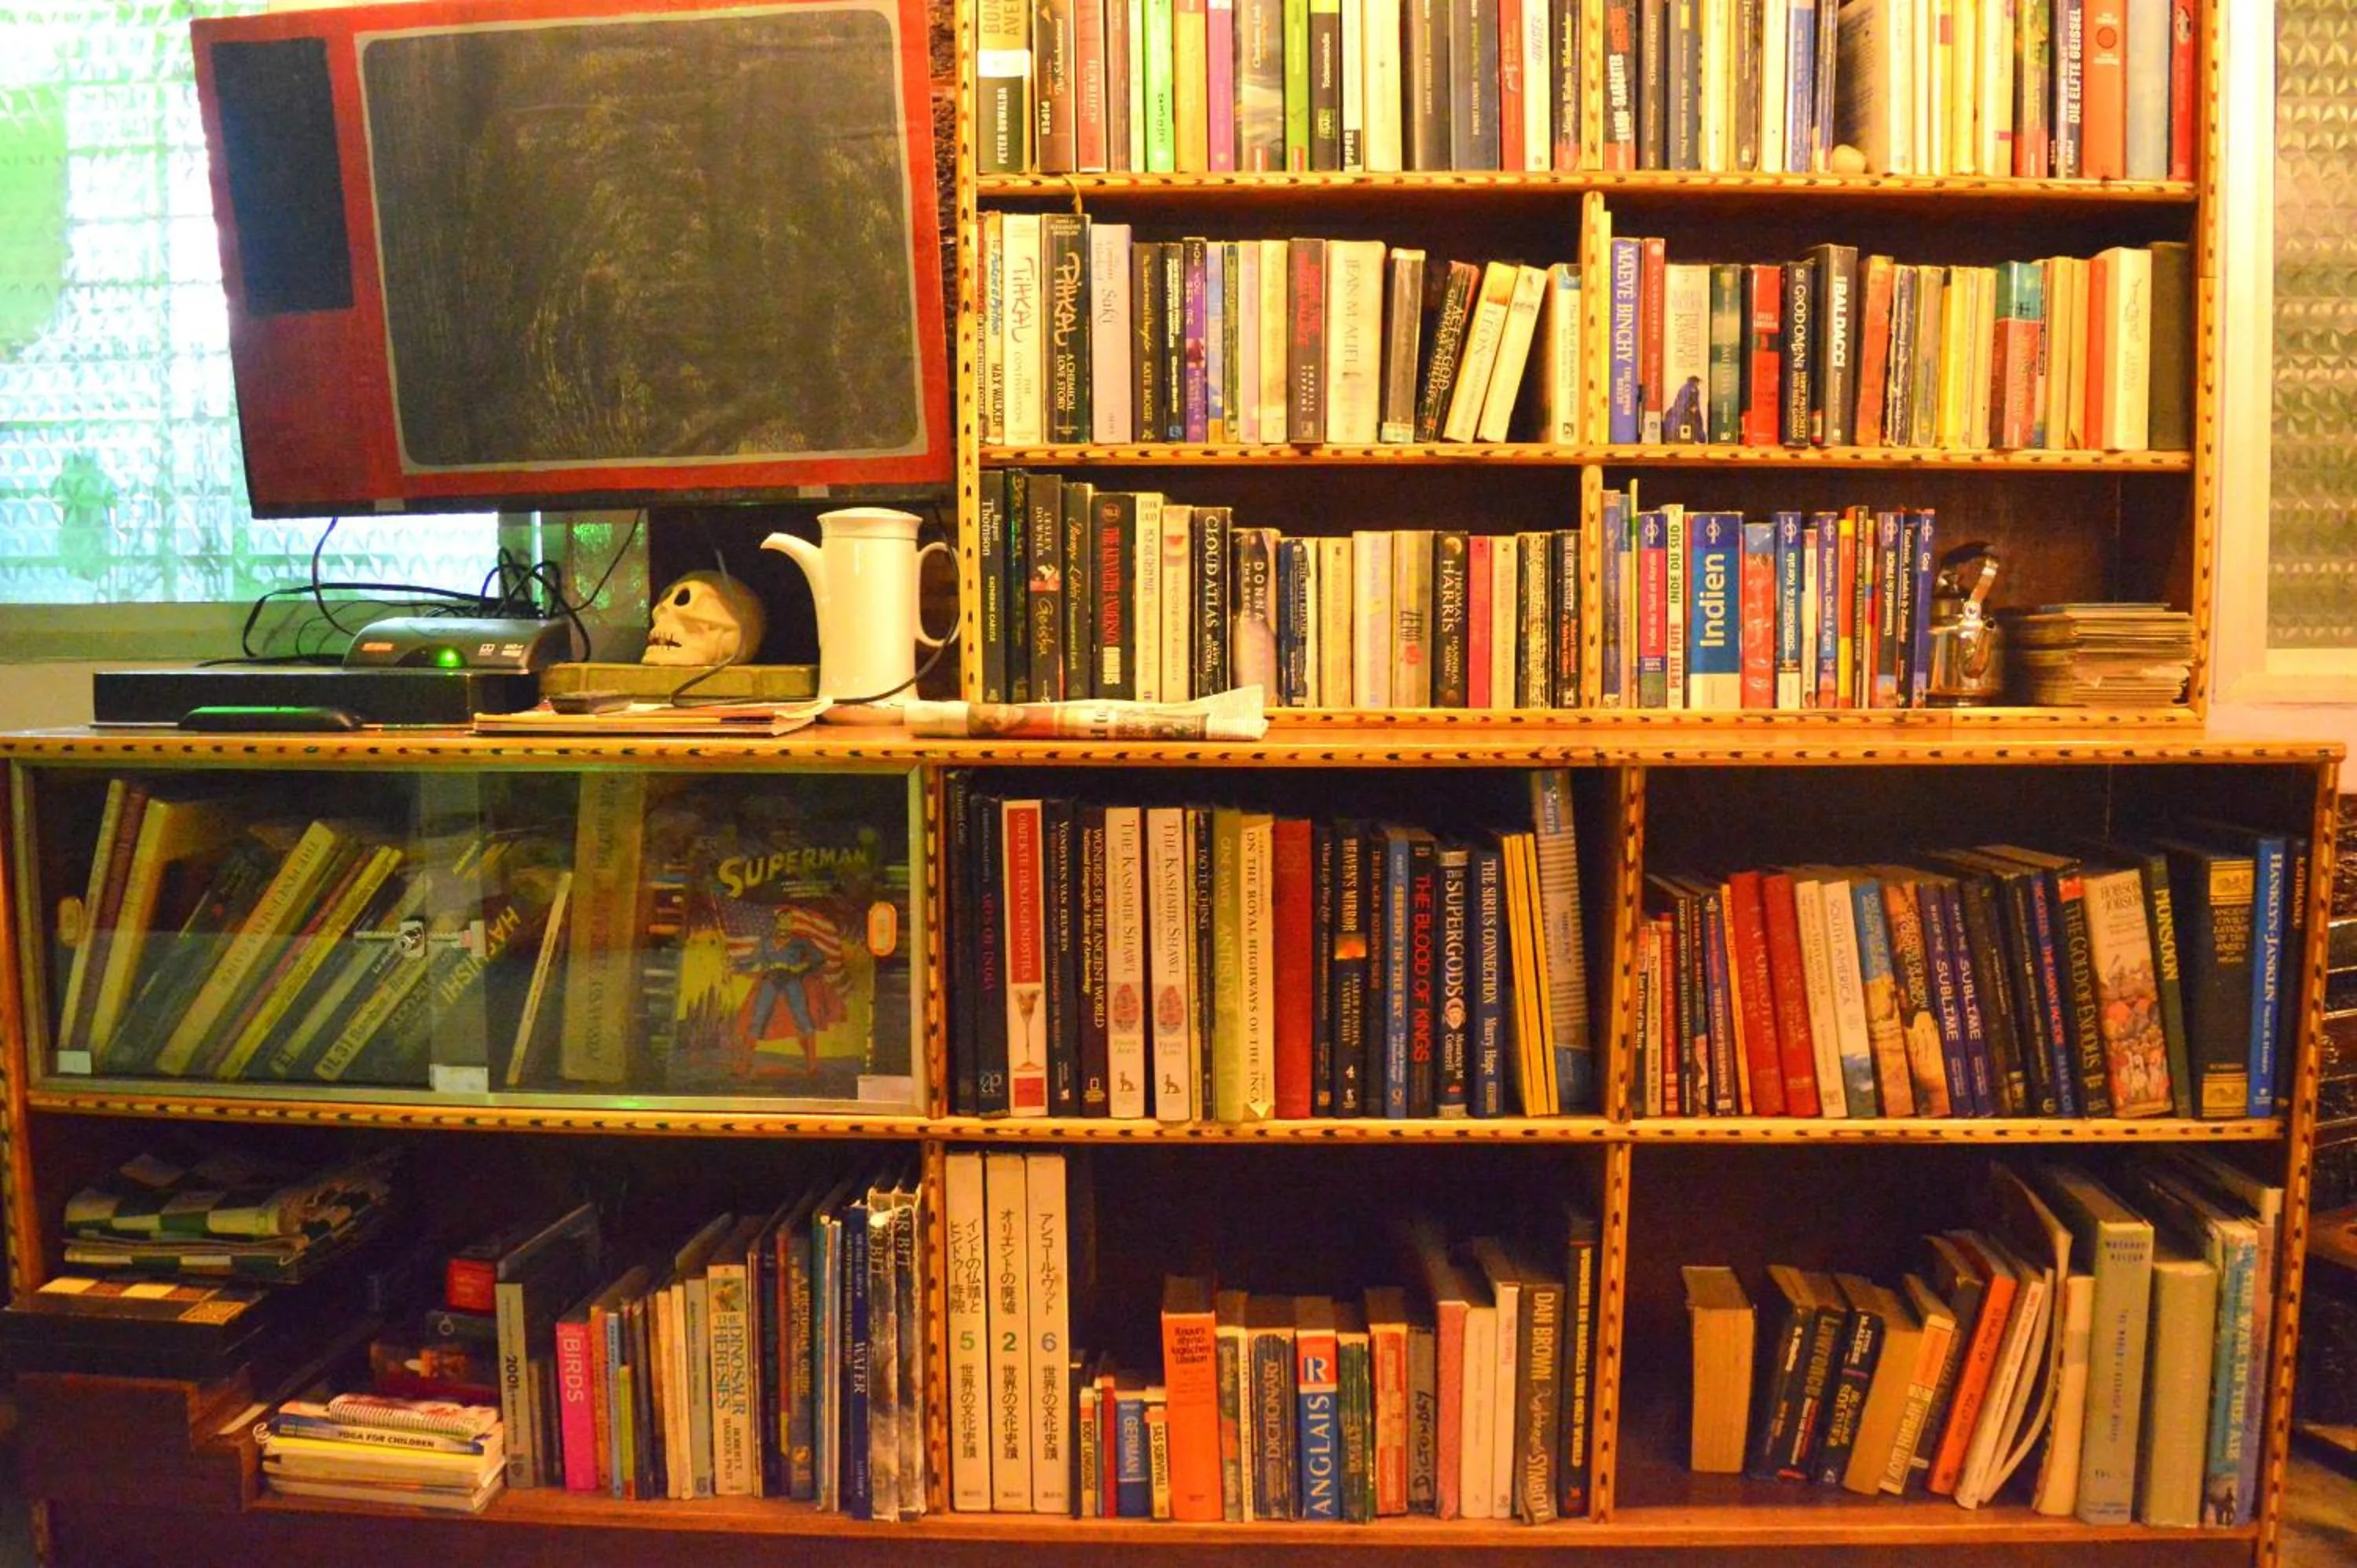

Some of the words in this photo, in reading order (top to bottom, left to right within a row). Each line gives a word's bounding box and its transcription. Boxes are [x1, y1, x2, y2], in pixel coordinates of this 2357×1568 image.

[2069, 8, 2081, 59] GEISSEL
[2069, 62, 2080, 99] ELFTE
[998, 87, 1008, 132] BUWALDA
[2069, 103, 2080, 123] DIE
[998, 135, 1008, 164] PETER
[1617, 246, 1637, 299] MAEVE
[1794, 284, 1806, 323] GOOD
[1616, 303, 1633, 362] BINCHY
[1791, 324, 1806, 368] OMENS
[1832, 283, 1848, 367] BALDACCI
[992, 363, 1003, 385] MAX
[1057, 355, 1066, 378] LOVE
[1438, 355, 1453, 390] GOD
[992, 388, 1003, 427] WALKER
[1057, 381, 1066, 411] STORY
[981, 498, 994, 556] Thomson
[1035, 506, 1043, 557] DOWNER
[1102, 527, 1120, 544] THE
[1204, 515, 1216, 575] CLOUD
[1670, 524, 1681, 549] SUD
[1102, 548, 1120, 592] KENNETH
[1670, 553, 1681, 570] DU
[1922, 552, 1930, 571] Goa
[1205, 578, 1216, 628] ATLAS
[1253, 561, 1264, 621] DONNA
[1442, 559, 1454, 632] HARRIS
[1670, 575, 1681, 604] INDE
[1699, 553, 1725, 647] Indien
[1036, 597, 1054, 658] Geisha
[1103, 595, 1120, 644] ANDERSON
[1670, 655, 1681, 690] PETIT
[1121, 819, 1136, 852] THE
[1164, 822, 1178, 854] THE
[1247, 831, 1256, 853] ON
[718, 848, 867, 898] SUPERMAN
[1093, 829, 1103, 887] WONDERS
[1247, 858, 1256, 885] THE
[1480, 859, 1497, 885] THE
[1094, 888, 1103, 904] OF
[1122, 855, 1137, 921] KASHMIR
[1164, 855, 1180, 925] KASHMIR
[1414, 874, 1431, 909] THE
[1481, 887, 1497, 926] SIRIUS
[1094, 907, 1103, 938] THE
[1247, 890, 1257, 936] ROYAL
[1342, 890, 1357, 932] MIRROR
[1393, 885, 1404, 942] SERPENT
[1395, 946, 1404, 962] IN
[1414, 913, 1431, 976] BLOOD
[1444, 880, 1464, 998] SUPERGODS
[2154, 888, 2179, 980] MONSOON
[1094, 940, 1104, 984] ANCIENT
[1248, 940, 1258, 1013] HIGHWAYS
[1394, 965, 1404, 989] THE
[1481, 929, 1497, 1005] CONNECTION
[1835, 946, 1853, 1006] AMERICA
[1094, 985, 1105, 1028] WORLD
[1393, 994, 1403, 1019] SKY
[1414, 980, 1431, 1004] OF
[1935, 958, 1959, 1041] SUBLIME
[1958, 958, 1980, 1040] SUBLIME
[1249, 1017, 1258, 1035] OF
[1413, 1008, 1430, 1062] KINGS
[1249, 1039, 1259, 1064] THE
[1249, 1070, 1259, 1105] INCA
[1534, 1292, 1555, 1323] DAN
[959, 1331, 976, 1350] 5
[1003, 1331, 1017, 1352] 2
[1041, 1332, 1058, 1353] 6
[1530, 1327, 1554, 1380] BROWN
[2235, 1313, 2253, 1357] WAR
[563, 1337, 583, 1403] BIRDS
[714, 1324, 730, 1409] HERESIES
[728, 1324, 745, 1416] DINOSAUR
[853, 1341, 866, 1394] WATER
[2234, 1361, 2251, 1383] IN
[1264, 1360, 1281, 1458] DICTIONARY
[2231, 1386, 2248, 1425] THE
[338, 1431, 363, 1442] YOGA
[366, 1433, 385, 1444] FOR
[387, 1435, 434, 1449] CHILDREN
[1083, 1420, 1093, 1443] BODY
[1124, 1416, 1139, 1474] GERMAN
[1153, 1424, 1163, 1442] SAS
[2227, 1430, 2242, 1461] AIR
[1083, 1445, 1094, 1491] LANGUAGE
[1153, 1444, 1165, 1486] SURVIVAL
[1307, 1395, 1332, 1515] ANGLAIS
